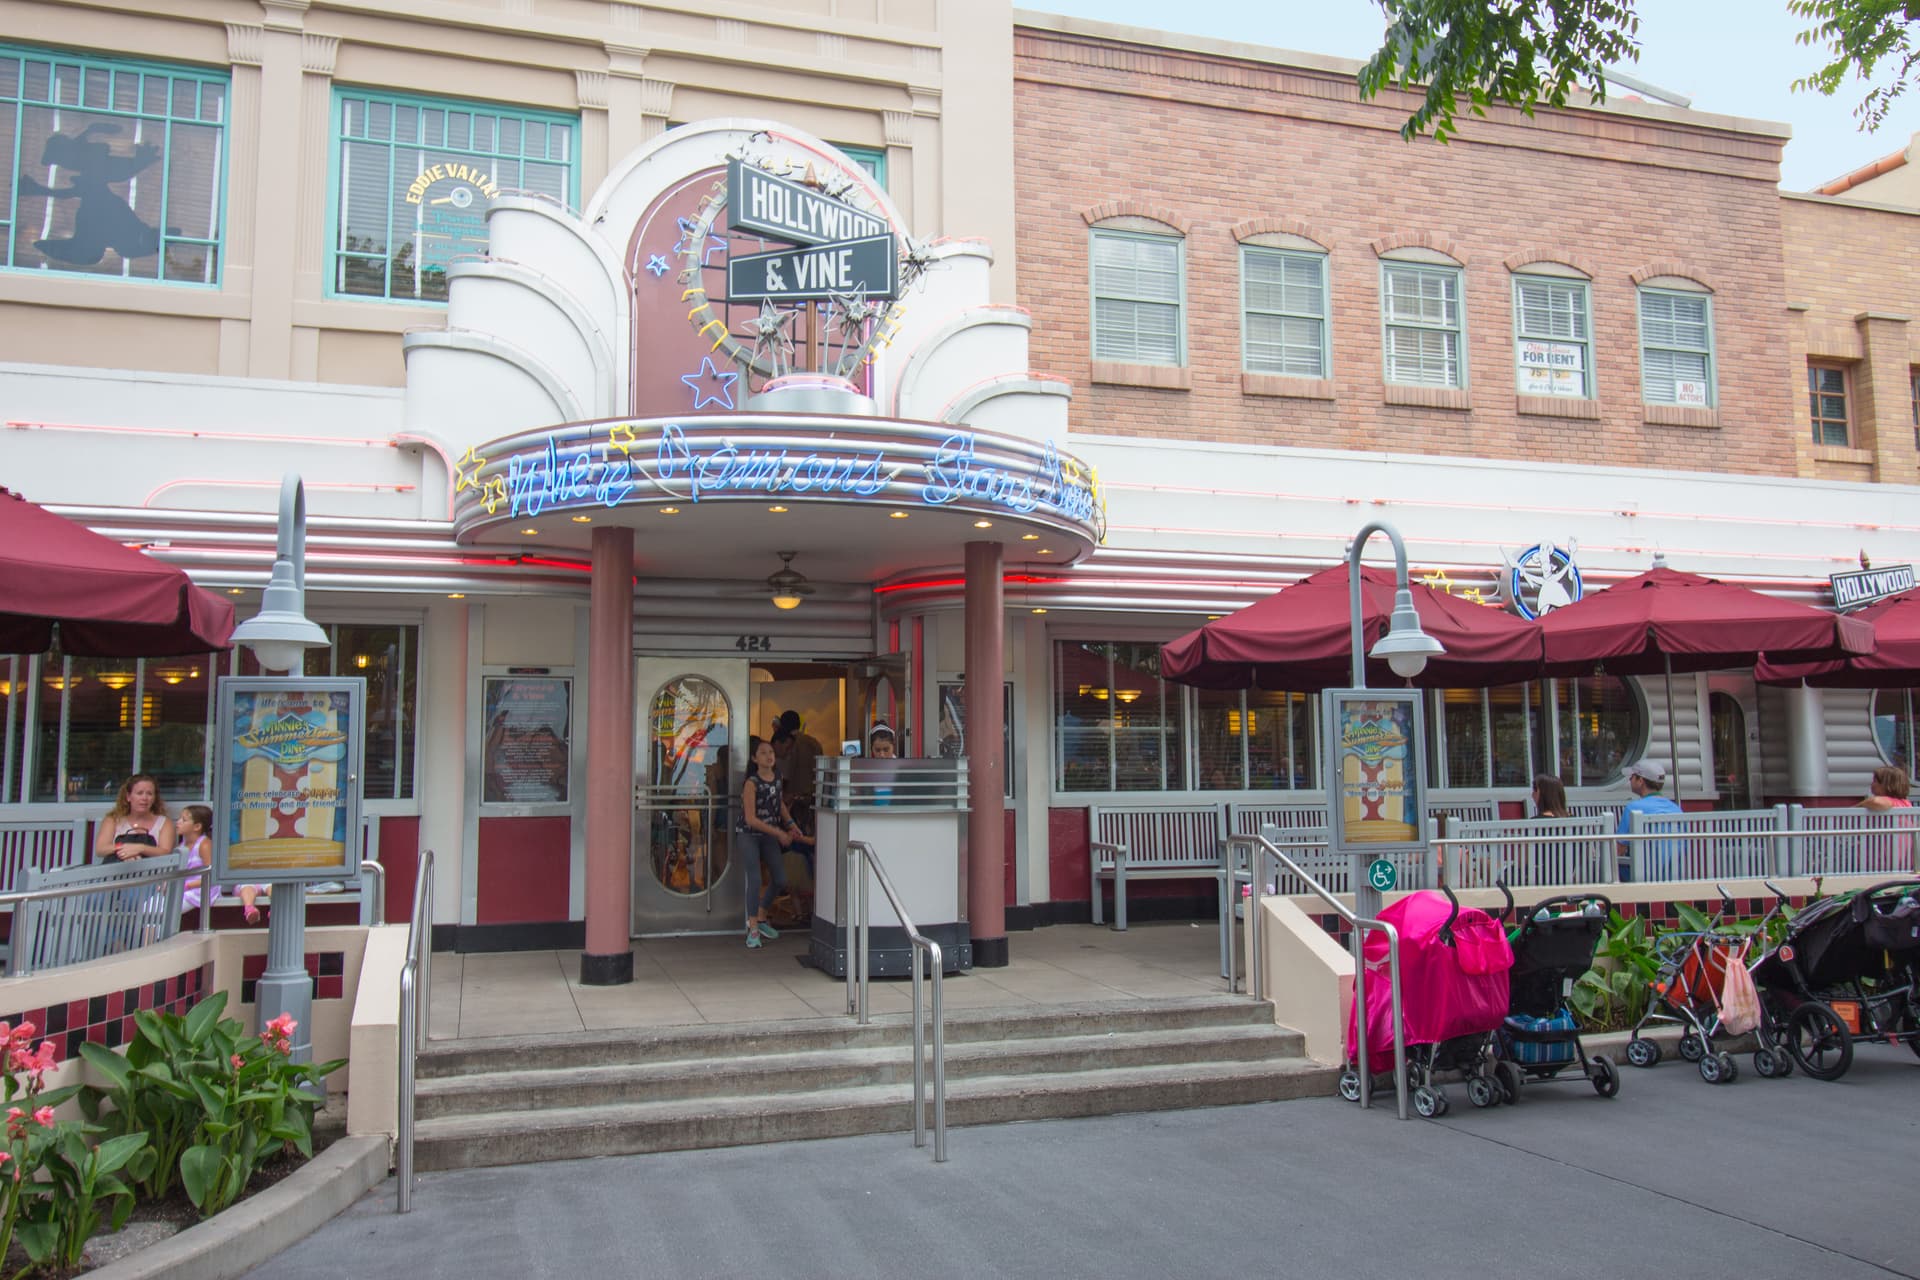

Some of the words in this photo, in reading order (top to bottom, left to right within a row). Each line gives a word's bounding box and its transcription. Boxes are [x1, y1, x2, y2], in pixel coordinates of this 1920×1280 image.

[406, 164, 445, 204] EDDIE
[751, 176, 881, 241] HOLLYWOOD
[766, 258, 788, 291] &
[792, 249, 853, 290] VINE
[1523, 351, 1544, 363] FOR
[1547, 353, 1576, 366] RENT
[1682, 383, 1694, 393] NO
[509, 433, 635, 518] Where
[657, 424, 893, 504] Famous
[923, 432, 1038, 514] Stars
[1836, 569, 1913, 603] HOLLYWOOD
[735, 635, 771, 651] 424
